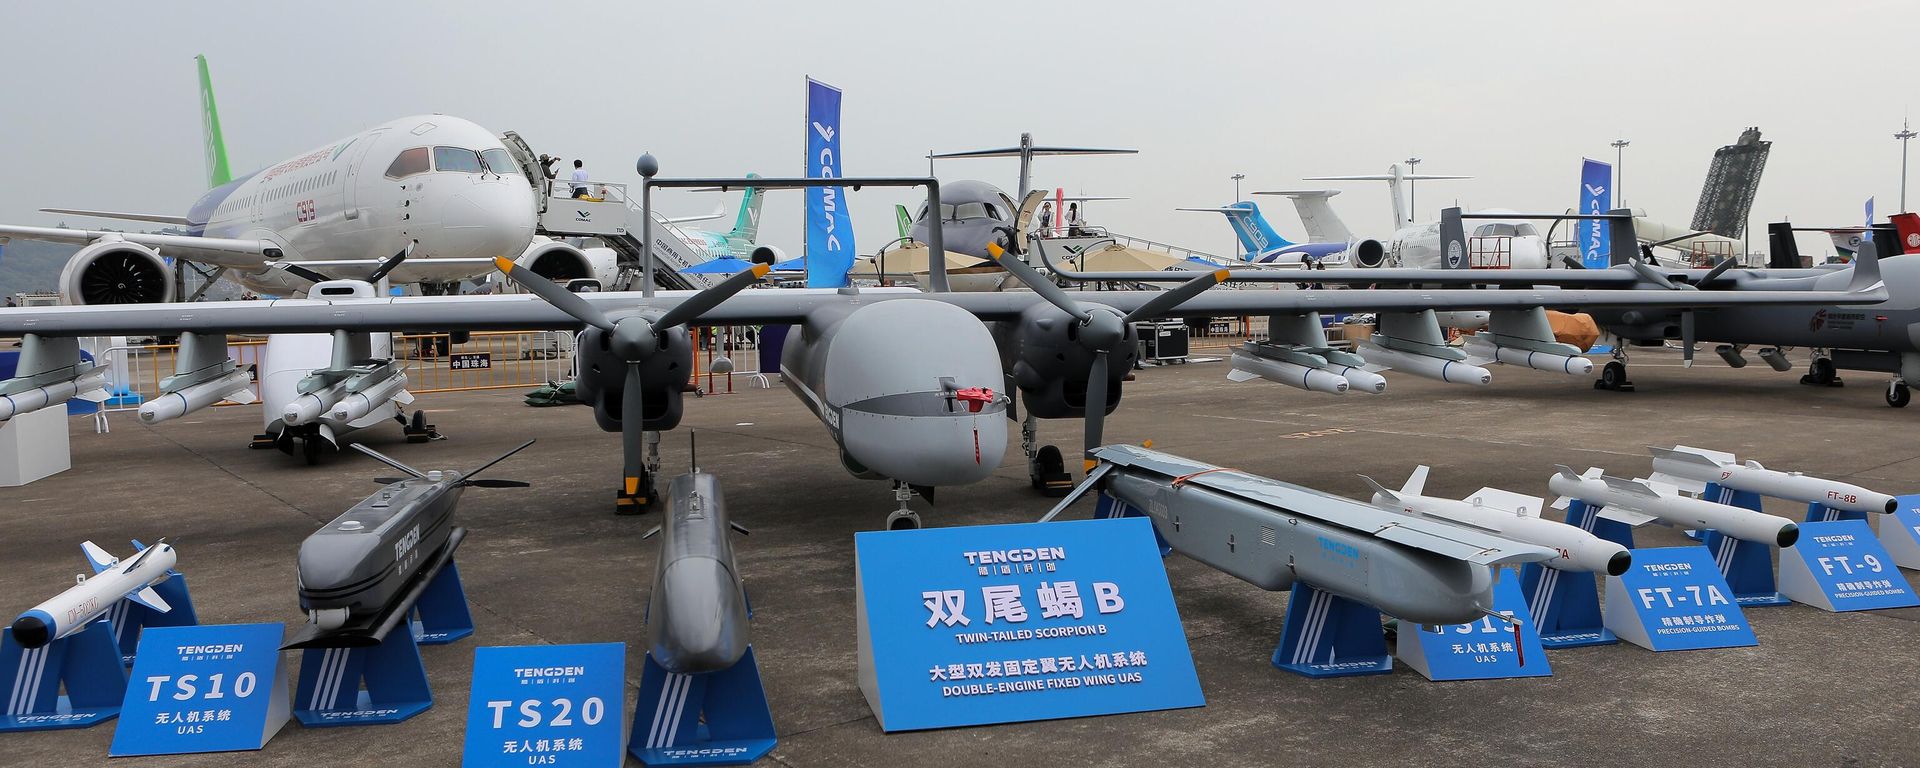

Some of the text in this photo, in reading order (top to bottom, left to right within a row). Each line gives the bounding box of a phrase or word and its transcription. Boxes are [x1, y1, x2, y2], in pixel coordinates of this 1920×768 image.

[297, 199, 316, 222] C919
[452, 359, 489, 369] 中国珠海
[1827, 491, 1857, 504] FT-8B
[395, 523, 420, 561] TENGDEN
[1814, 535, 1855, 544] TENGDEN
[964, 547, 1066, 566] TENGDEN
[1643, 563, 1692, 572] TENGDEN
[1817, 554, 1882, 576] FT-9
[1638, 585, 1729, 609] FT-7A
[1434, 610, 1516, 634] S15
[956, 624, 1107, 644] TWIN-TAILED SCORPION B
[1656, 624, 1740, 635] PRECISION-GUIDED BOMBS
[177, 644, 243, 655] TENGDEN
[1451, 642, 1514, 654] 无人机系统
[929, 650, 1148, 681] 大型双发固定翼无人机系统
[1475, 655, 1498, 663] UAS
[514, 666, 584, 677] TENGDEN
[146, 671, 257, 702] TS10
[942, 672, 1143, 698] DOUBLE-ENGINE FIXED WING UAS
[155, 709, 231, 725] 无人机系统
[320, 709, 398, 718] TENGDEN
[487, 697, 605, 729] TS20
[177, 725, 204, 735] UAS
[503, 737, 583, 754] 无人机系统
[663, 747, 748, 756] TENGDEN
[528, 754, 556, 765] UAS
